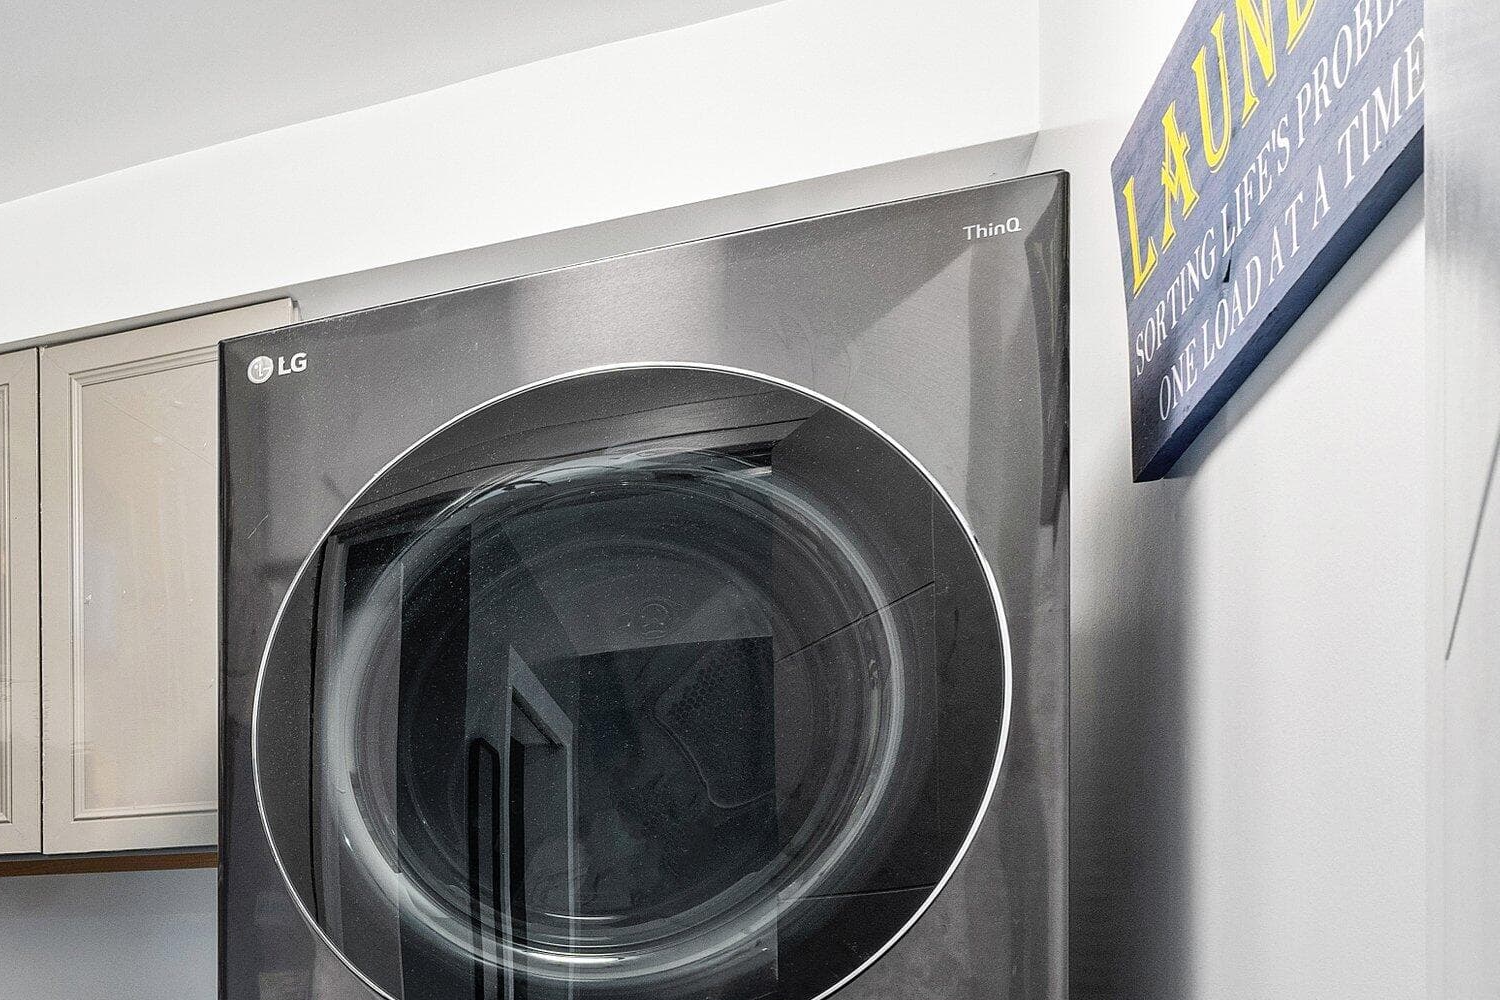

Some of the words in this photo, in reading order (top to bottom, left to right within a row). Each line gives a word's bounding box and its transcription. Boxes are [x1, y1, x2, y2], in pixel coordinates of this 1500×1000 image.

[962, 217, 1022, 240] ThinQ
[1136, 227, 1217, 377] SORTING
[1220, 115, 1290, 256] LIFE'S
[1296, 0, 1405, 148] PROBL
[1159, 342, 1197, 420] ONE
[1202, 254, 1262, 369] LOAD
[1268, 193, 1304, 285] AT
[1311, 165, 1330, 230] A
[1338, 28, 1425, 190] TIME
[278, 352, 307, 376] LG
